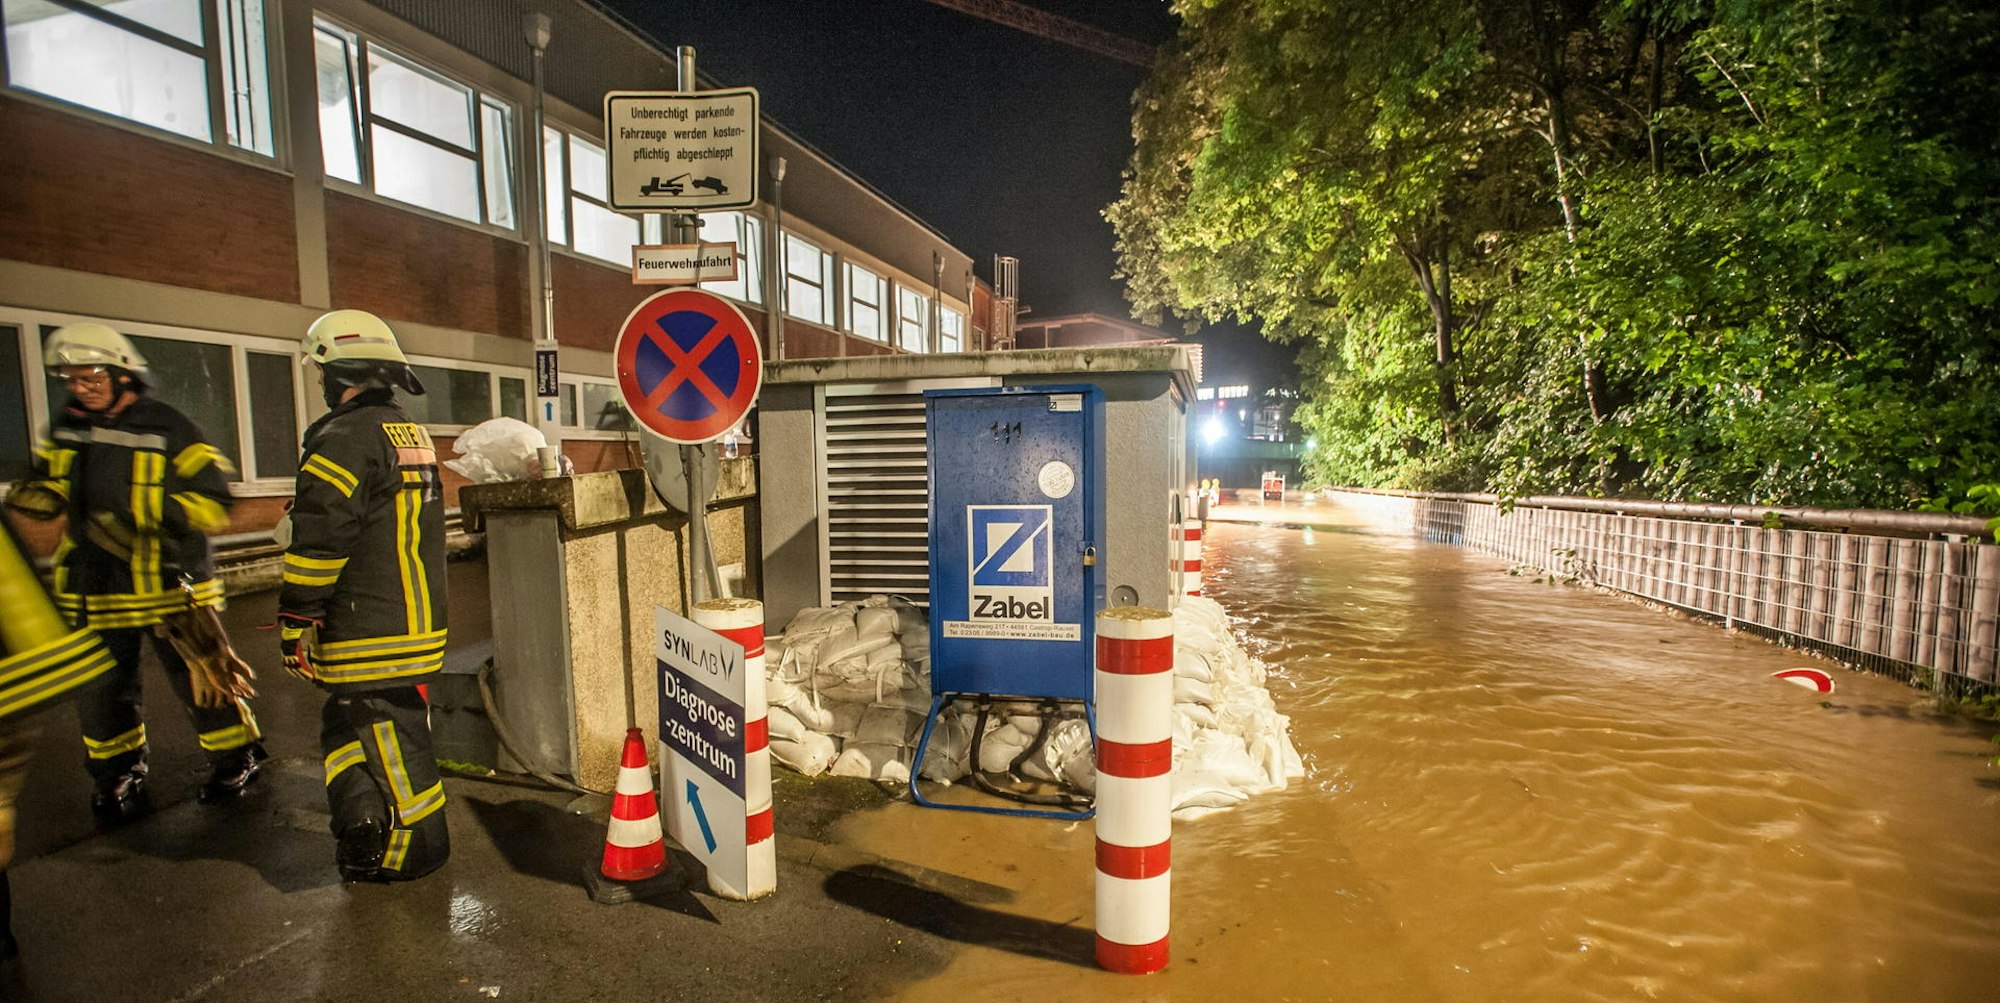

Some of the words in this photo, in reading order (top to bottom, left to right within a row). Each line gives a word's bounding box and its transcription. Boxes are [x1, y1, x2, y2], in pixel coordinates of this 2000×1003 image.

[631, 107, 688, 121] Unberechtigt
[695, 105, 735, 121] parkende
[620, 127, 667, 142] Fahrzeuge
[674, 128, 707, 139] werden
[713, 126, 745, 138] kosten-
[633, 147, 670, 162] pflichtig
[677, 146, 733, 162] abgeschleppt
[639, 256, 731, 270] Feuerwehrufahrt
[973, 595, 1049, 620] Zabel
[664, 629, 718, 675] SYNLAB
[664, 670, 736, 738] Diagnose
[666, 718, 736, 779] -zentrum
